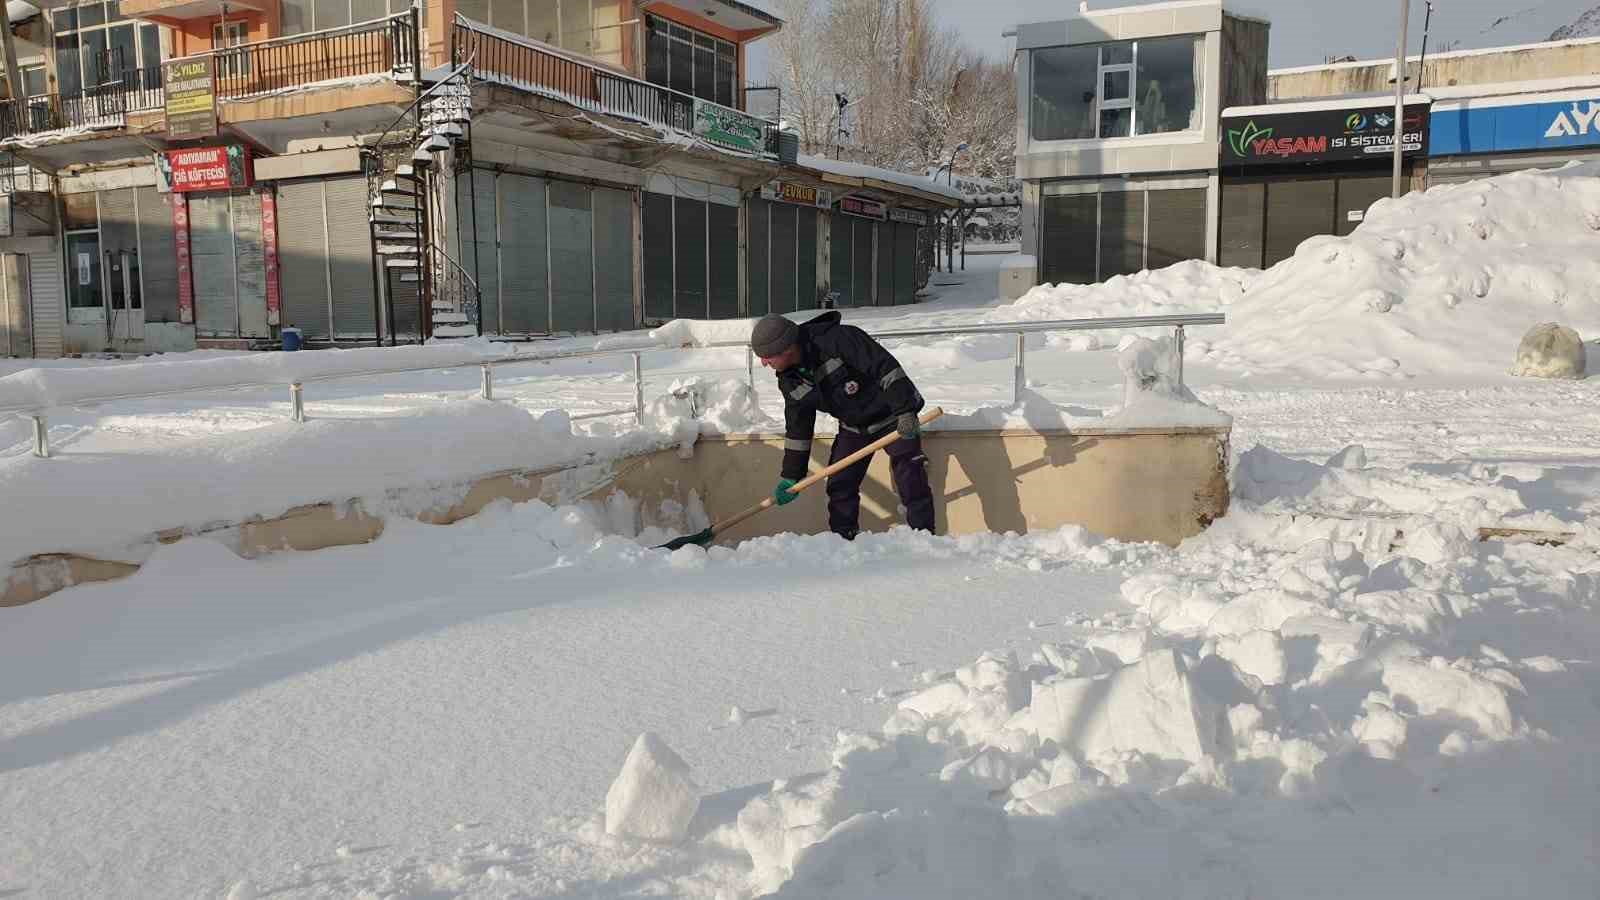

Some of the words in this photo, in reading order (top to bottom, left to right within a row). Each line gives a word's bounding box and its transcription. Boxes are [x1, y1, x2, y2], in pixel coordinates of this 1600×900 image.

[181, 62, 206, 76] YILDIZ
[1543, 102, 1600, 137] AY
[1253, 136, 1328, 158] YAŞAM
[1331, 138, 1347, 148] ISI
[1350, 130, 1422, 147] SİSTEMERİ
[178, 150, 218, 165] ADIYAMAN
[187, 164, 226, 182] KÖFTECİSİ
